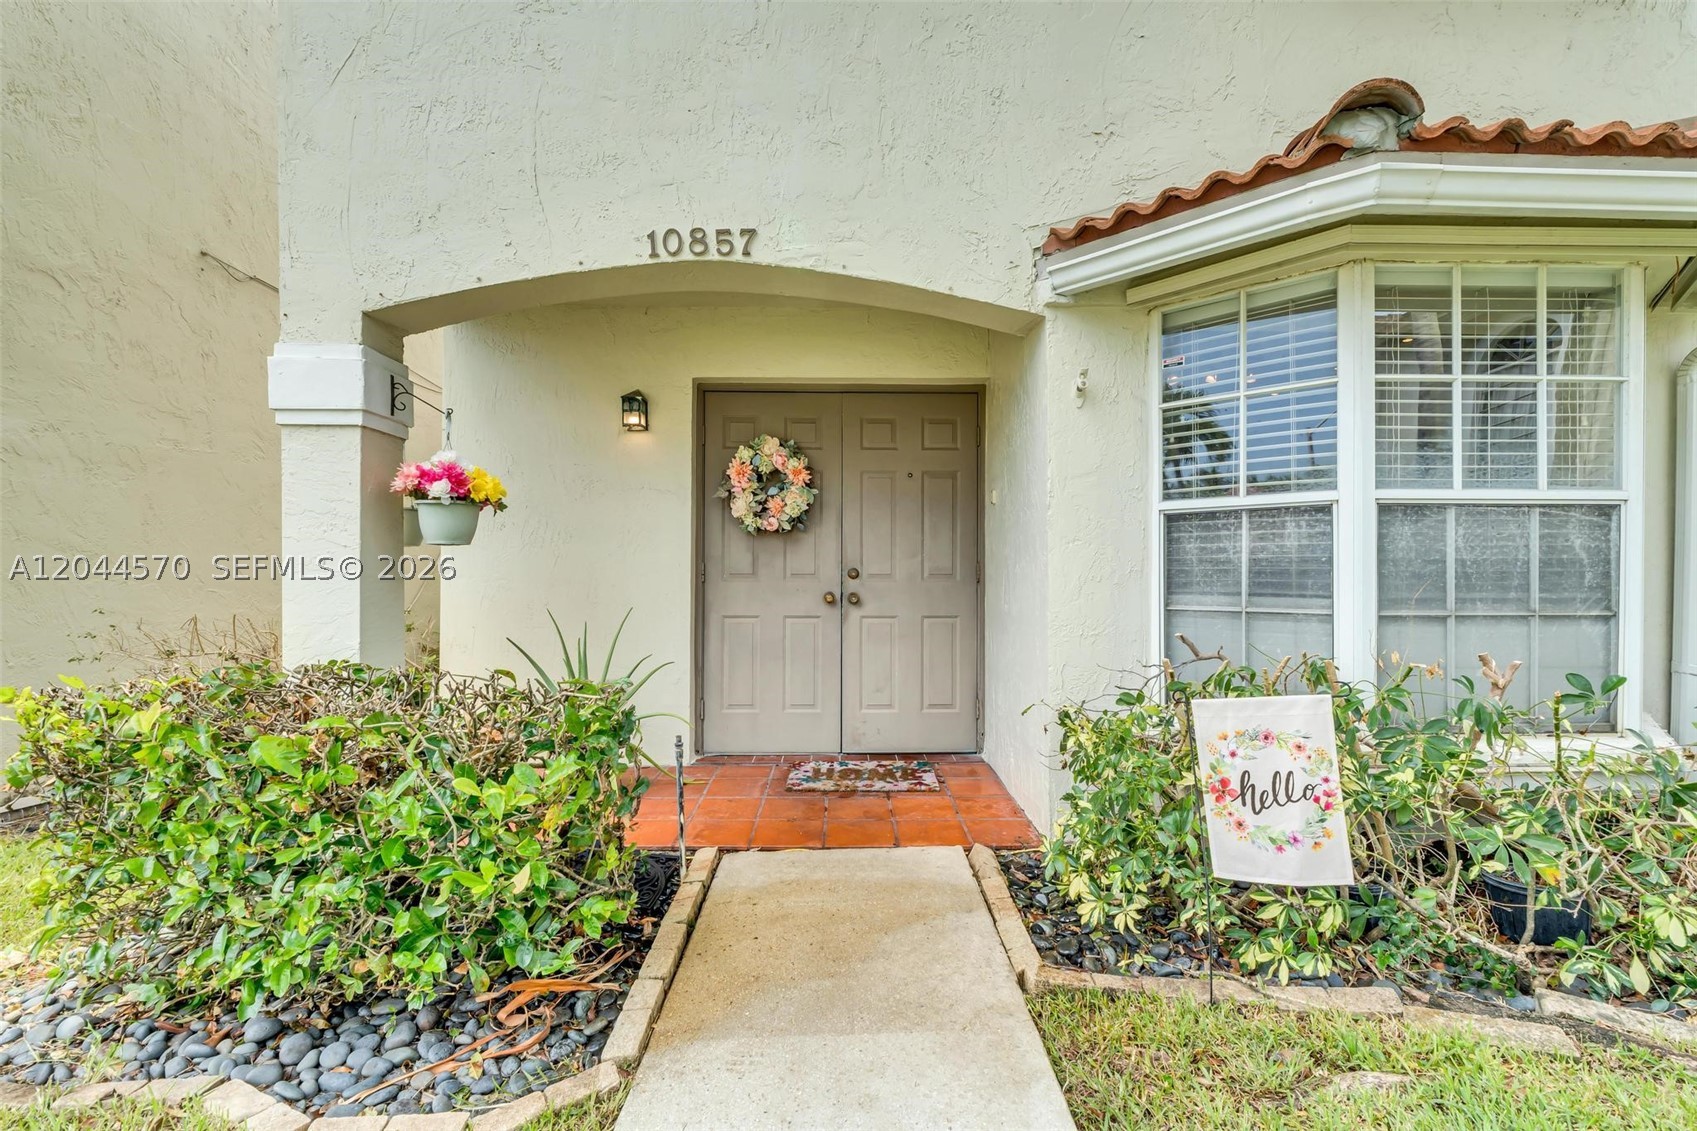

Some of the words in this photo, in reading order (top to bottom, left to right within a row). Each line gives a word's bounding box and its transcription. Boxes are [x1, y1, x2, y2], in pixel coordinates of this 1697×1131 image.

[647, 227, 757, 258] 10857
[811, 767, 920, 783] HOME
[1231, 769, 1322, 815] hello
